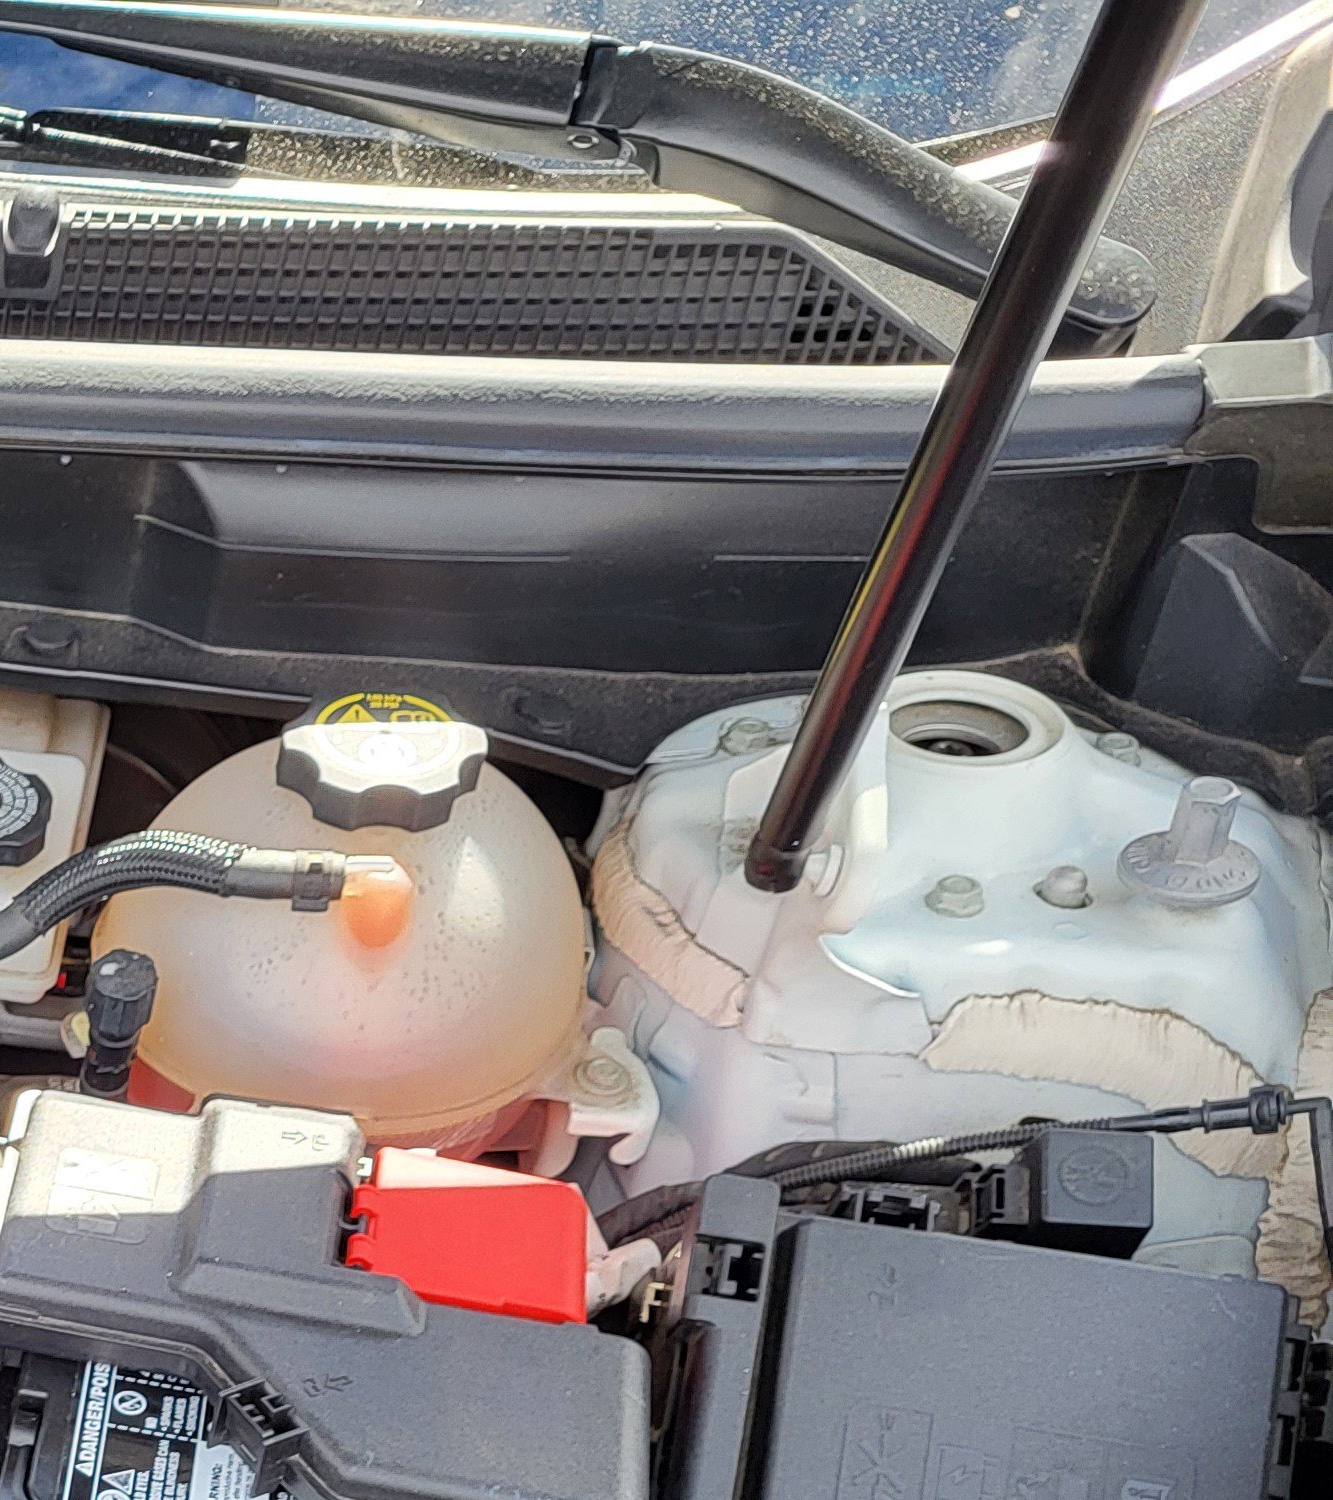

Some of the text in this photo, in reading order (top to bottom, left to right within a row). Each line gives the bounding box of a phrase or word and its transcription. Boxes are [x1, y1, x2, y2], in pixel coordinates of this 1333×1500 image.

[79, 1364, 109, 1462] DANGER/POIS
[157, 1440, 169, 1457] CAN
[164, 1452, 180, 1496] BLINDNESS
